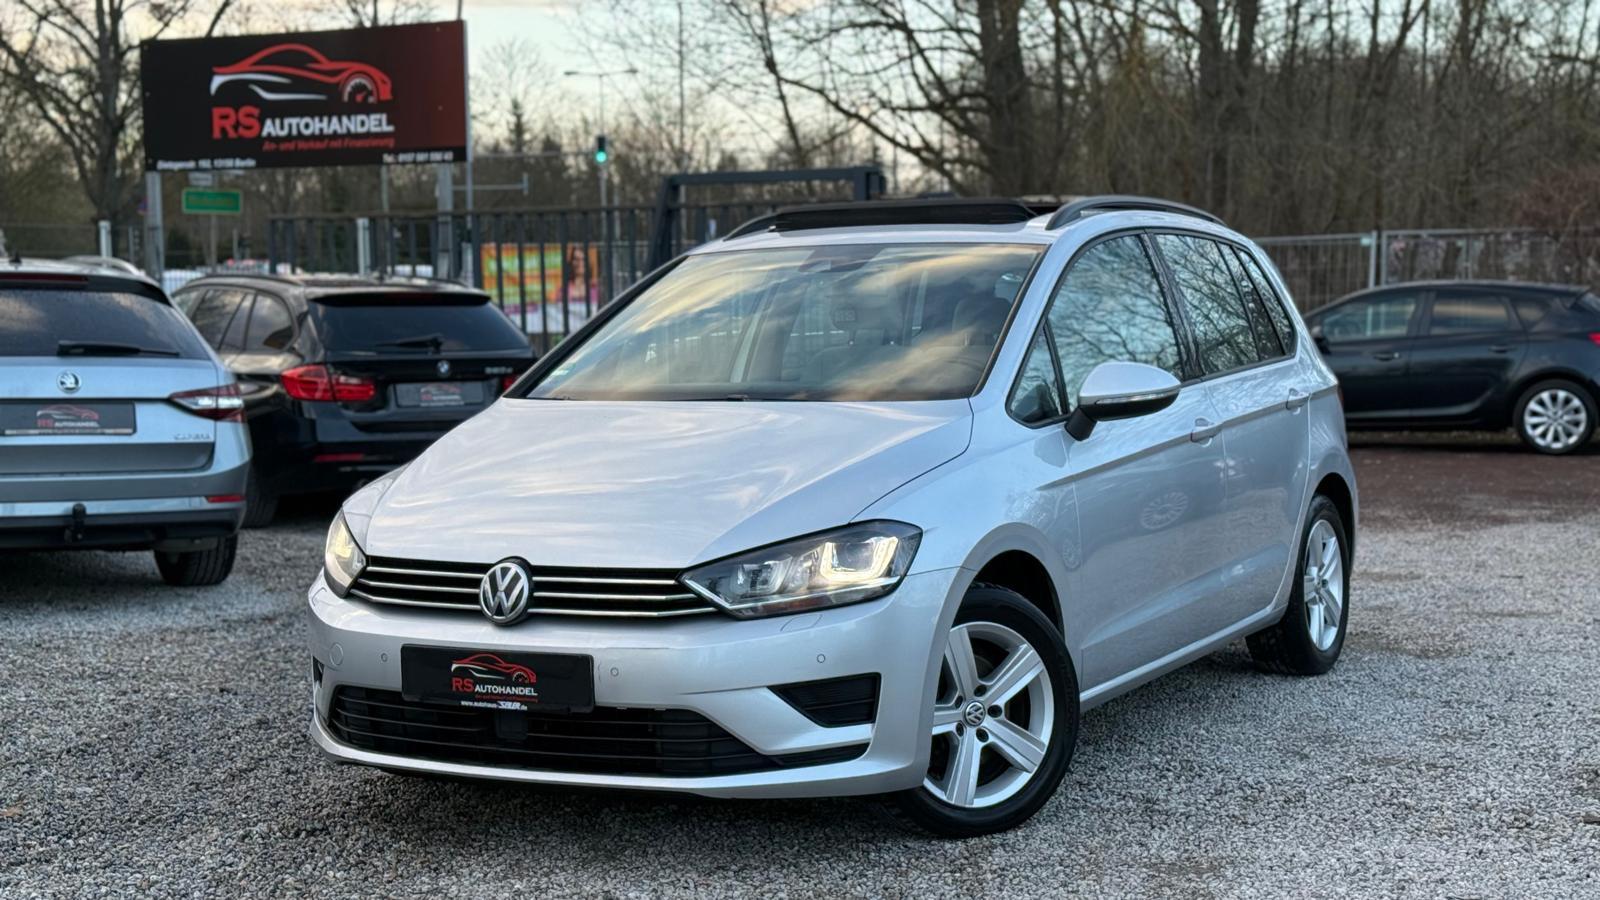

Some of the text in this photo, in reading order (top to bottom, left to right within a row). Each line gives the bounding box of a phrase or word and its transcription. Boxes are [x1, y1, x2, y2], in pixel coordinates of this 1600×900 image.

[211, 106, 395, 139] RS AUTOHANDEL
[452, 677, 538, 696] RS AUTOHANDEL
